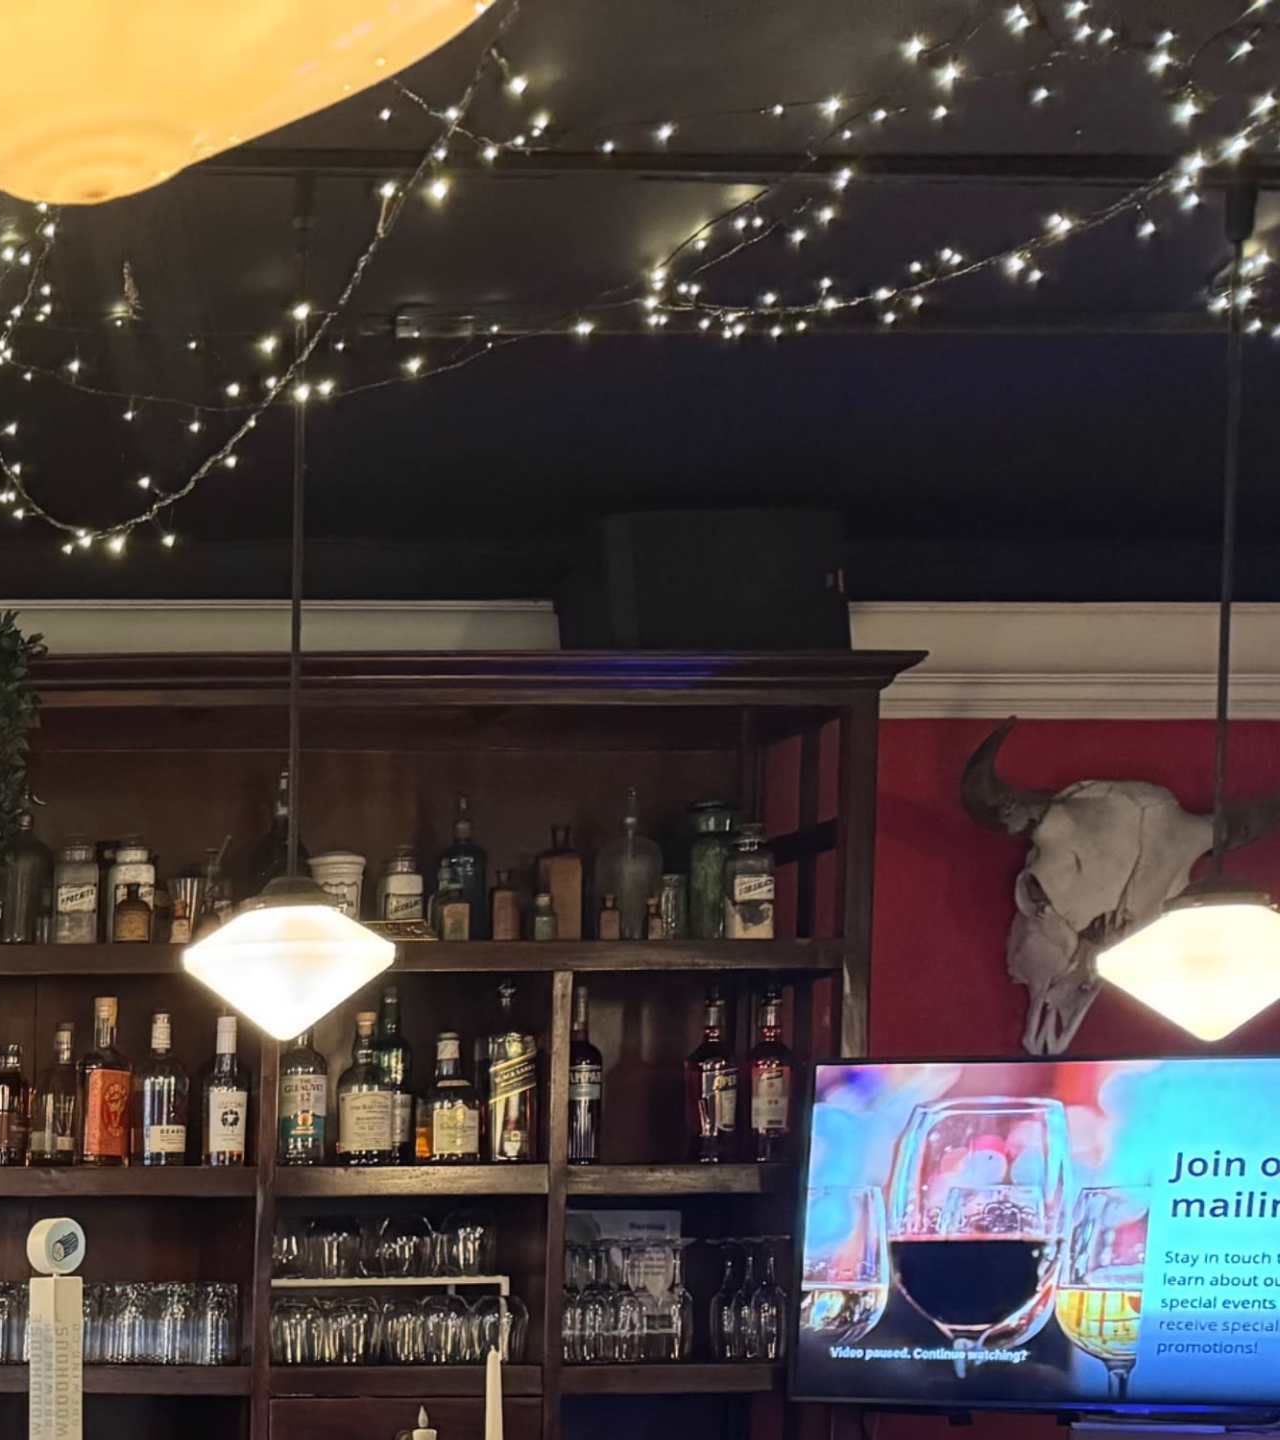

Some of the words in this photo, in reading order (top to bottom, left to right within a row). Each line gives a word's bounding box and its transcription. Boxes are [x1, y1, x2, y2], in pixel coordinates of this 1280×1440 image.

[1168, 1150, 1247, 1183] Join
[1165, 1251, 1200, 1267] Stay
[1205, 1253, 1220, 1264] in
[1225, 1252, 1272, 1264] touch
[1163, 1273, 1205, 1286] learn
[1210, 1275, 1258, 1287] about
[1161, 1296, 1217, 1311] special
[1222, 1299, 1277, 1309] events
[1159, 1319, 1218, 1331] receive
[1221, 1320, 1280, 1335] special
[830, 1347, 863, 1358] Video
[865, 1347, 911, 1361] paused.
[913, 1348, 966, 1360] Continue
[967, 1349, 1028, 1364] watching?
[1156, 1341, 1259, 1356] promotions!
